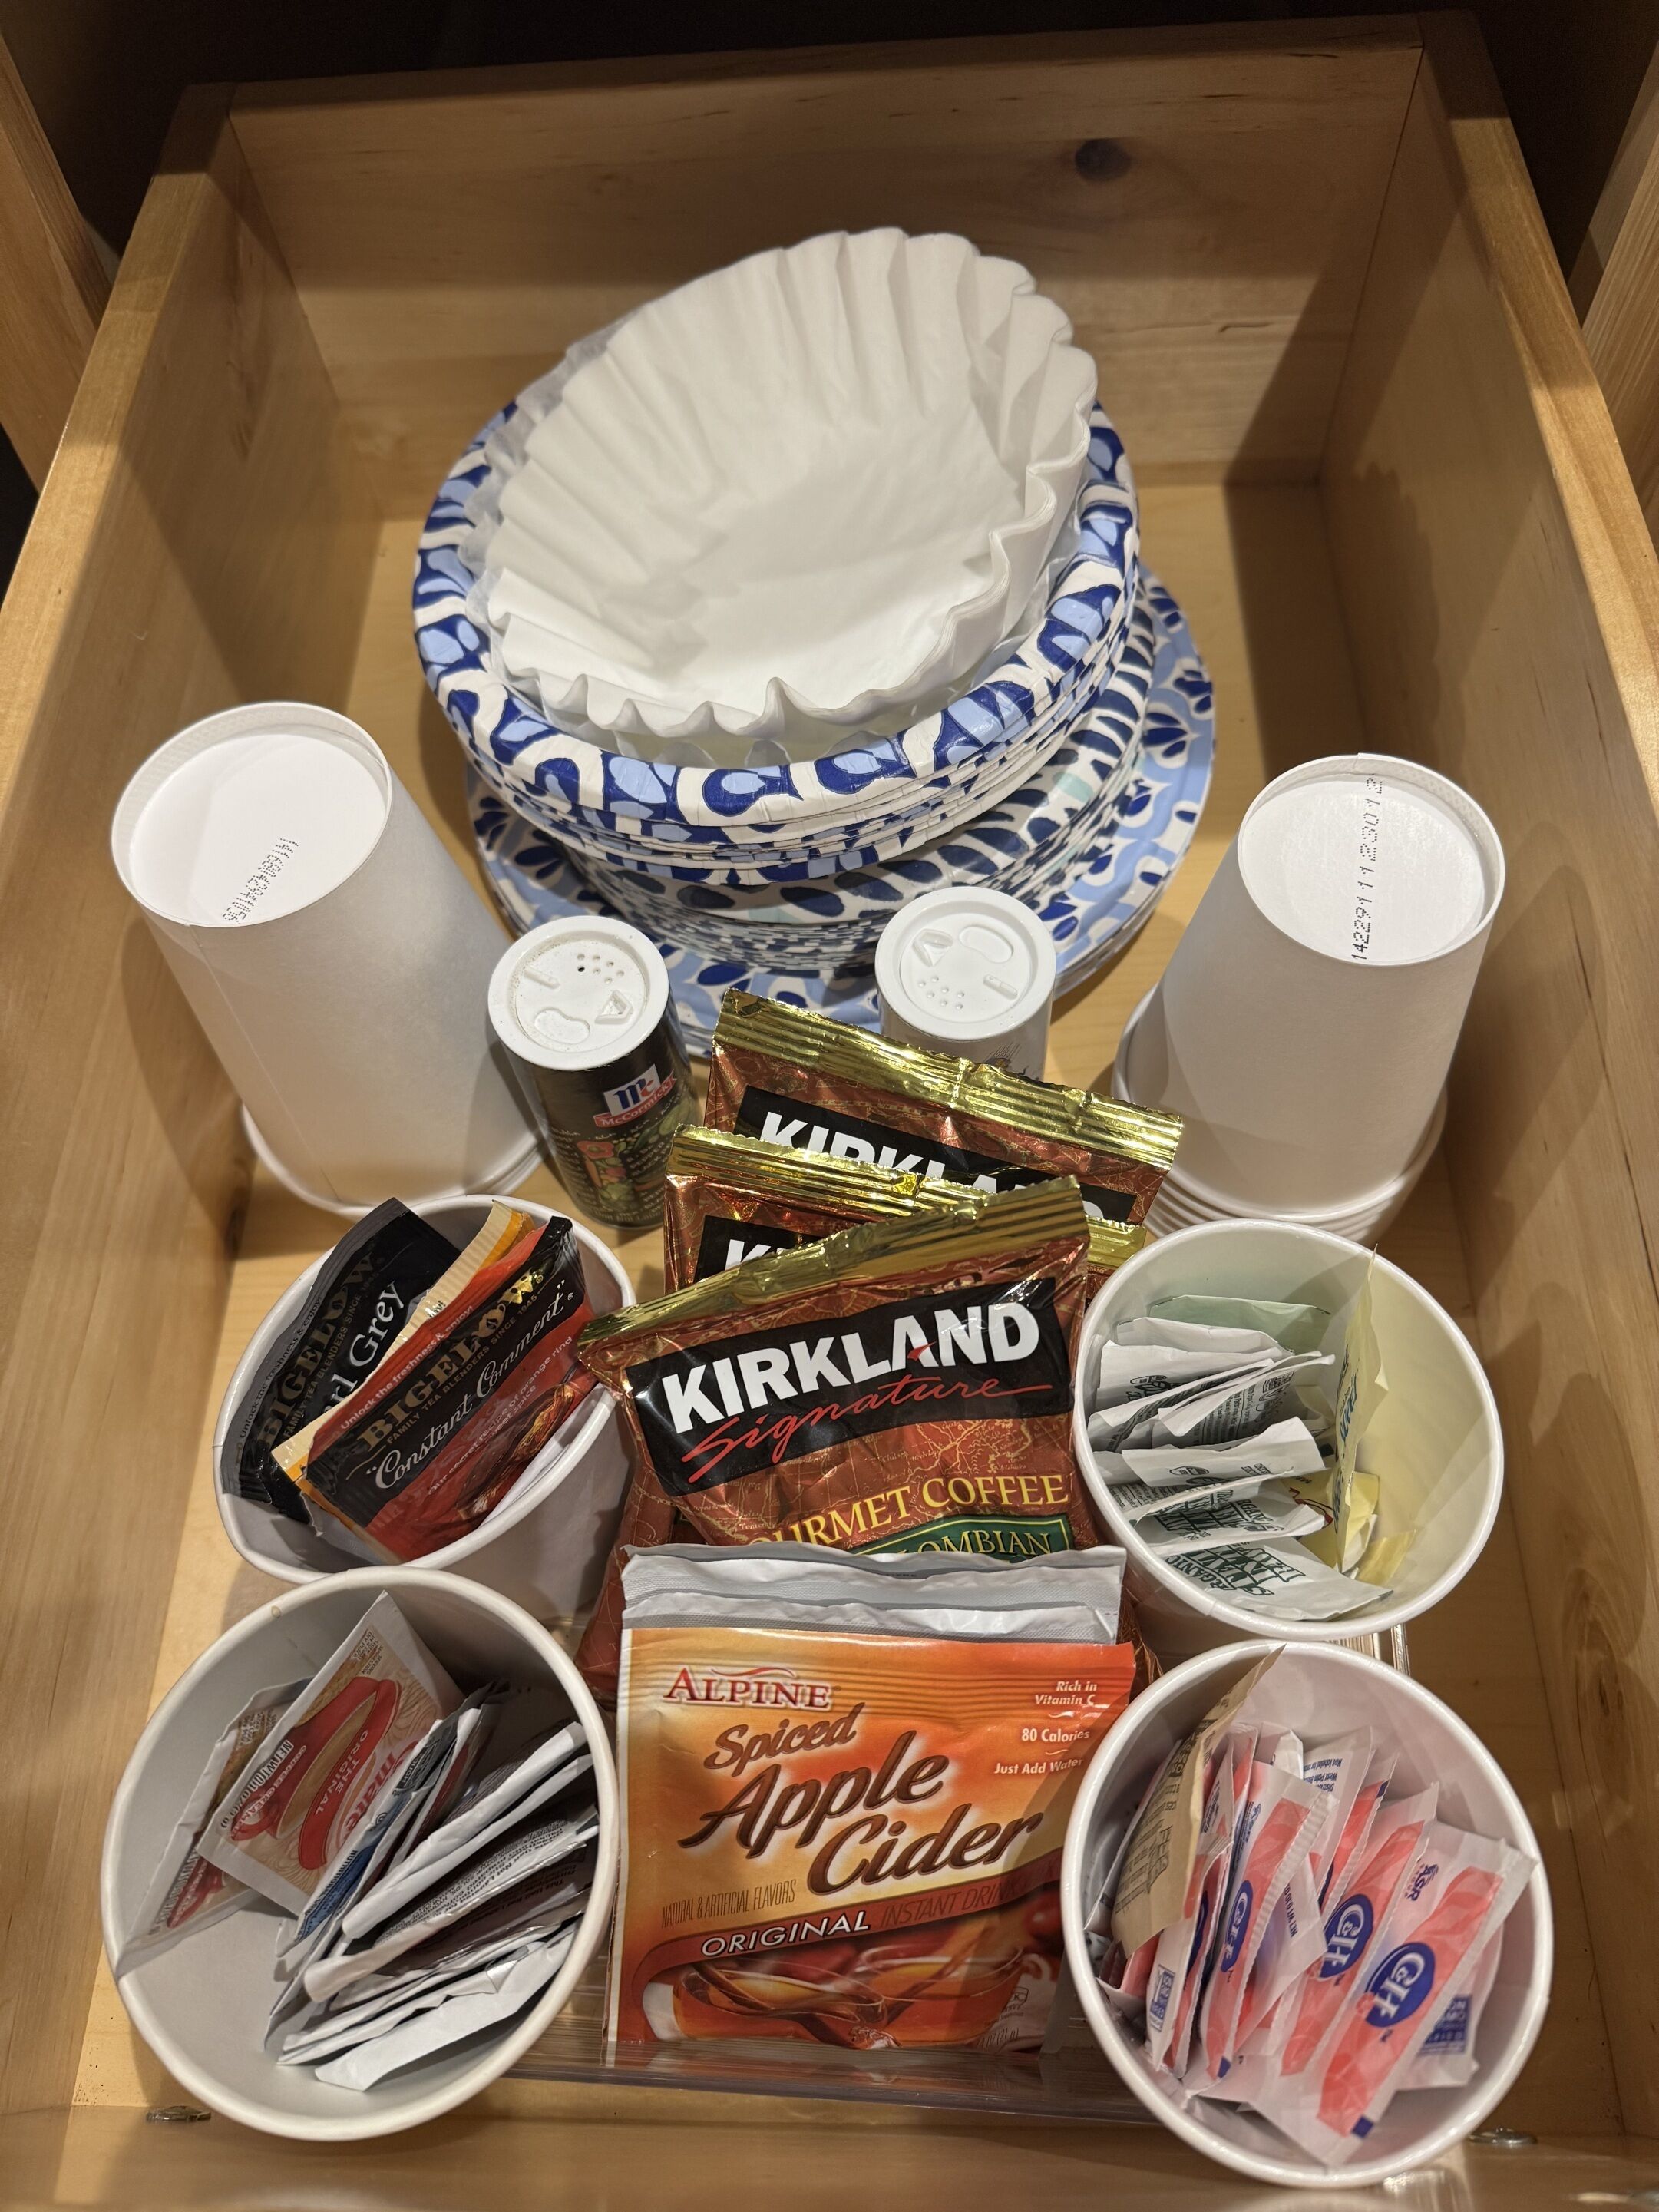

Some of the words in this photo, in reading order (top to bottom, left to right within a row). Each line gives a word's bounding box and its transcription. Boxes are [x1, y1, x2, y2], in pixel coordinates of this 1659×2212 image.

[600, 1080, 673, 1127] McCormick
[258, 1251, 374, 1447] BIGELOW
[349, 1281, 405, 1367] Grey
[356, 1269, 539, 1453] BIGELOW
[240, 1400, 259, 1438] Unlock
[256, 1384, 268, 1402] the
[265, 1336, 300, 1387] freshness
[296, 1328, 305, 1337] &
[302, 1296, 322, 1329] enjoy!
[283, 1401, 307, 1440] FAMILY
[304, 1382, 317, 1402] TEA
[317, 1327, 349, 1380] BLENDERS
[345, 1294, 362, 1327] SINCE
[340, 1398, 376, 1431] Unlock
[374, 1380, 394, 1400] the
[392, 1338, 439, 1386] freshness
[435, 1332, 446, 1341] &
[443, 1304, 475, 1338] enjoy!
[387, 1411, 421, 1447] FAMILY
[422, 1392, 444, 1412] TEA
[442, 1347, 491, 1393] BLENDERS
[489, 1316, 517, 1344] SINCE
[517, 1294, 538, 1316] 1945
[512, 1384, 538, 1413] spice
[660, 1301, 1040, 1434] KIRKLAND
[446, 1443, 480, 1478] secret
[479, 1407, 511, 1443] recipe
[507, 1394, 521, 1408] of
[519, 1357, 552, 1399] orange
[550, 1335, 574, 1360] rind
[681, 1377, 1053, 1483] Signature
[923, 1473, 1069, 1509] COFFEE
[663, 1666, 831, 1710] ALPINE
[1035, 1695, 1082, 1704] Vitamin
[1087, 1694, 1096, 1705] C
[1056, 1680, 1081, 1691] Rich
[1085, 1681, 1097, 1691] in
[259, 1759, 279, 1777] WT
[273, 1740, 294, 1764] NET
[313, 1728, 369, 1817] ORIGINAL
[704, 1702, 865, 1777] Spiced
[994, 1763, 1019, 1774] Just
[1022, 1762, 1046, 1774] Add
[1049, 1758, 1082, 1771] Water
[1022, 1728, 1037, 1741] 80
[1042, 1728, 1089, 1742] Calories
[334, 1757, 359, 1795] THE
[679, 1731, 950, 1860] Apple
[808, 1804, 1043, 1896] Cider
[1406, 1864, 1432, 1901] ASR
[662, 1903, 693, 1928] NATURAL
[704, 1888, 750, 1915] ARTIFICIAL
[753, 1880, 797, 1909] FLAVORS
[701, 1909, 871, 1957] ORIGINAL
[879, 1889, 957, 1928] INSTANT
[1221, 1889, 1251, 1969] C&H
[1288, 1908, 1294, 1923] WT
[1325, 1903, 1365, 1978] C&H
[1373, 1946, 1430, 2021] C&H
